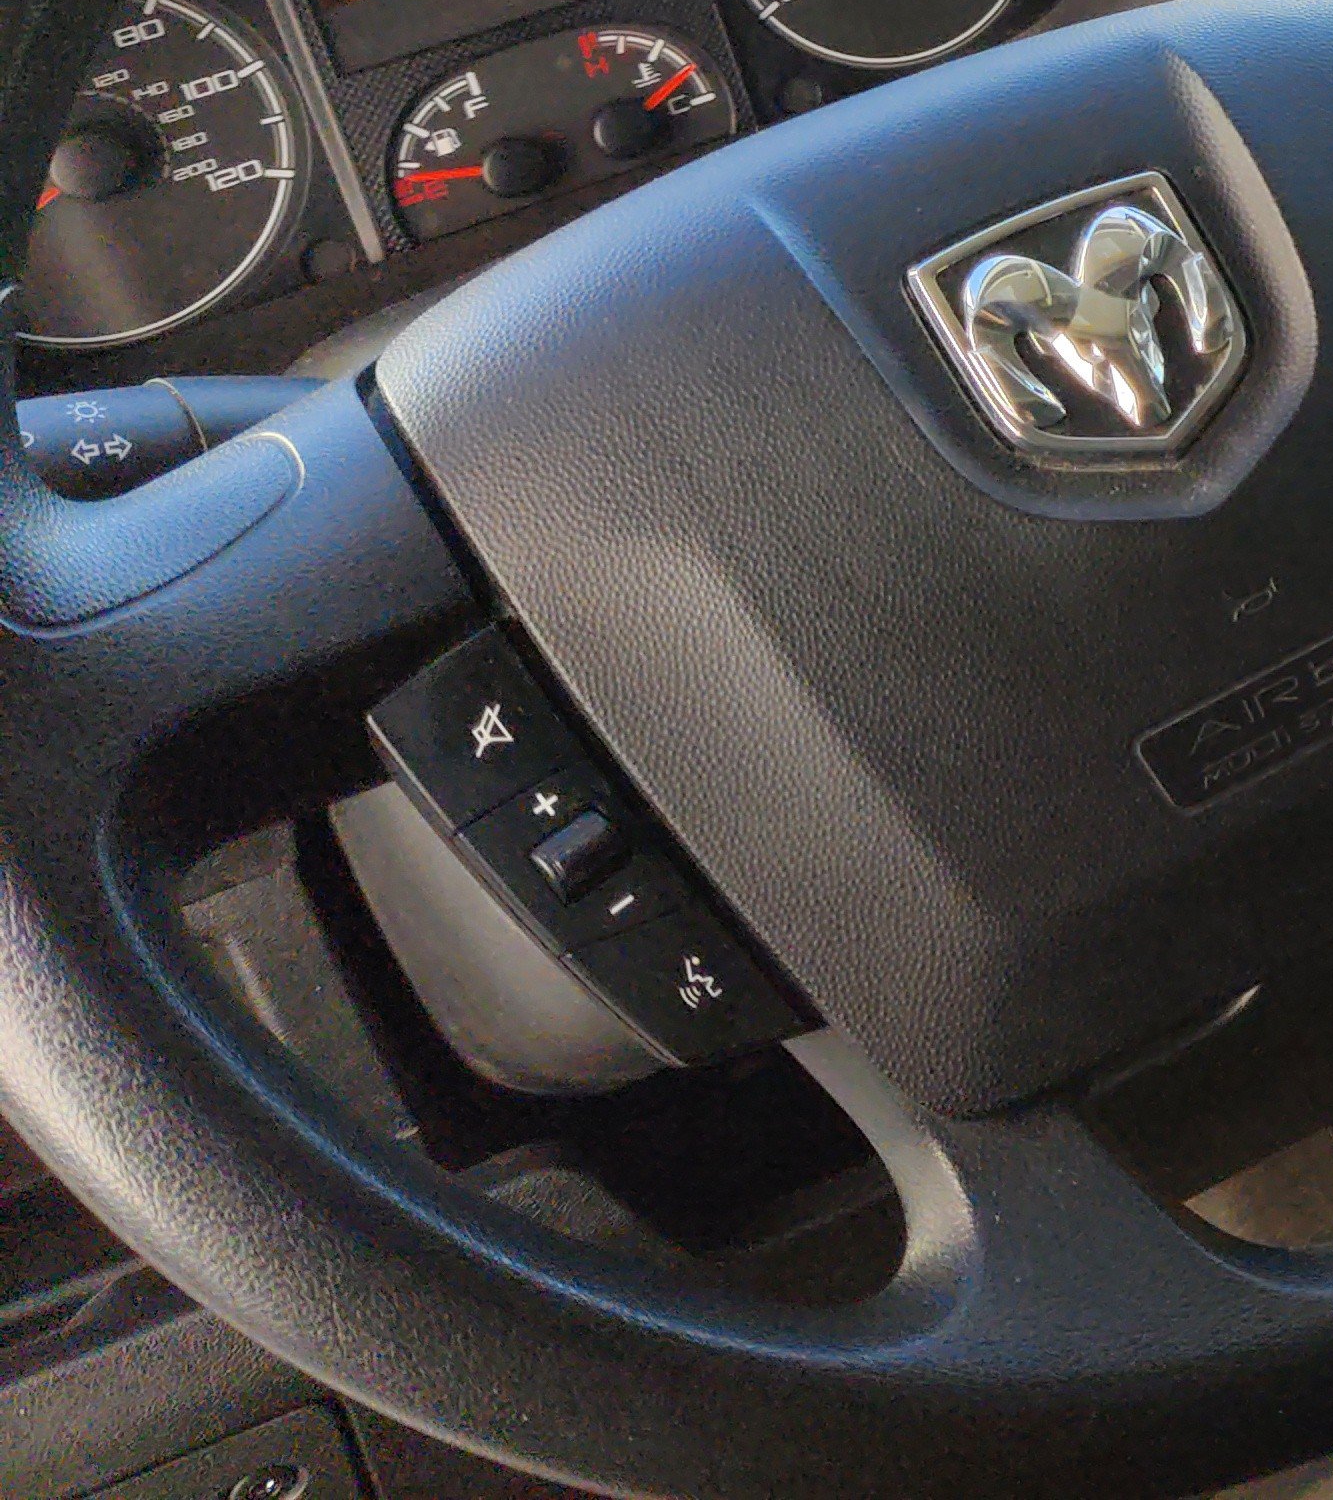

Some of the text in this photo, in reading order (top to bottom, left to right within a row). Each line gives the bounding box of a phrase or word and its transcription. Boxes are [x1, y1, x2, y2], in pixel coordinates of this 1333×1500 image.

[112, 18, 165, 49] 80
[93, 68, 130, 89] 120
[180, 69, 239, 101] 100
[463, 95, 490, 120] F
[667, 94, 692, 116] C
[204, 159, 263, 192] 120
